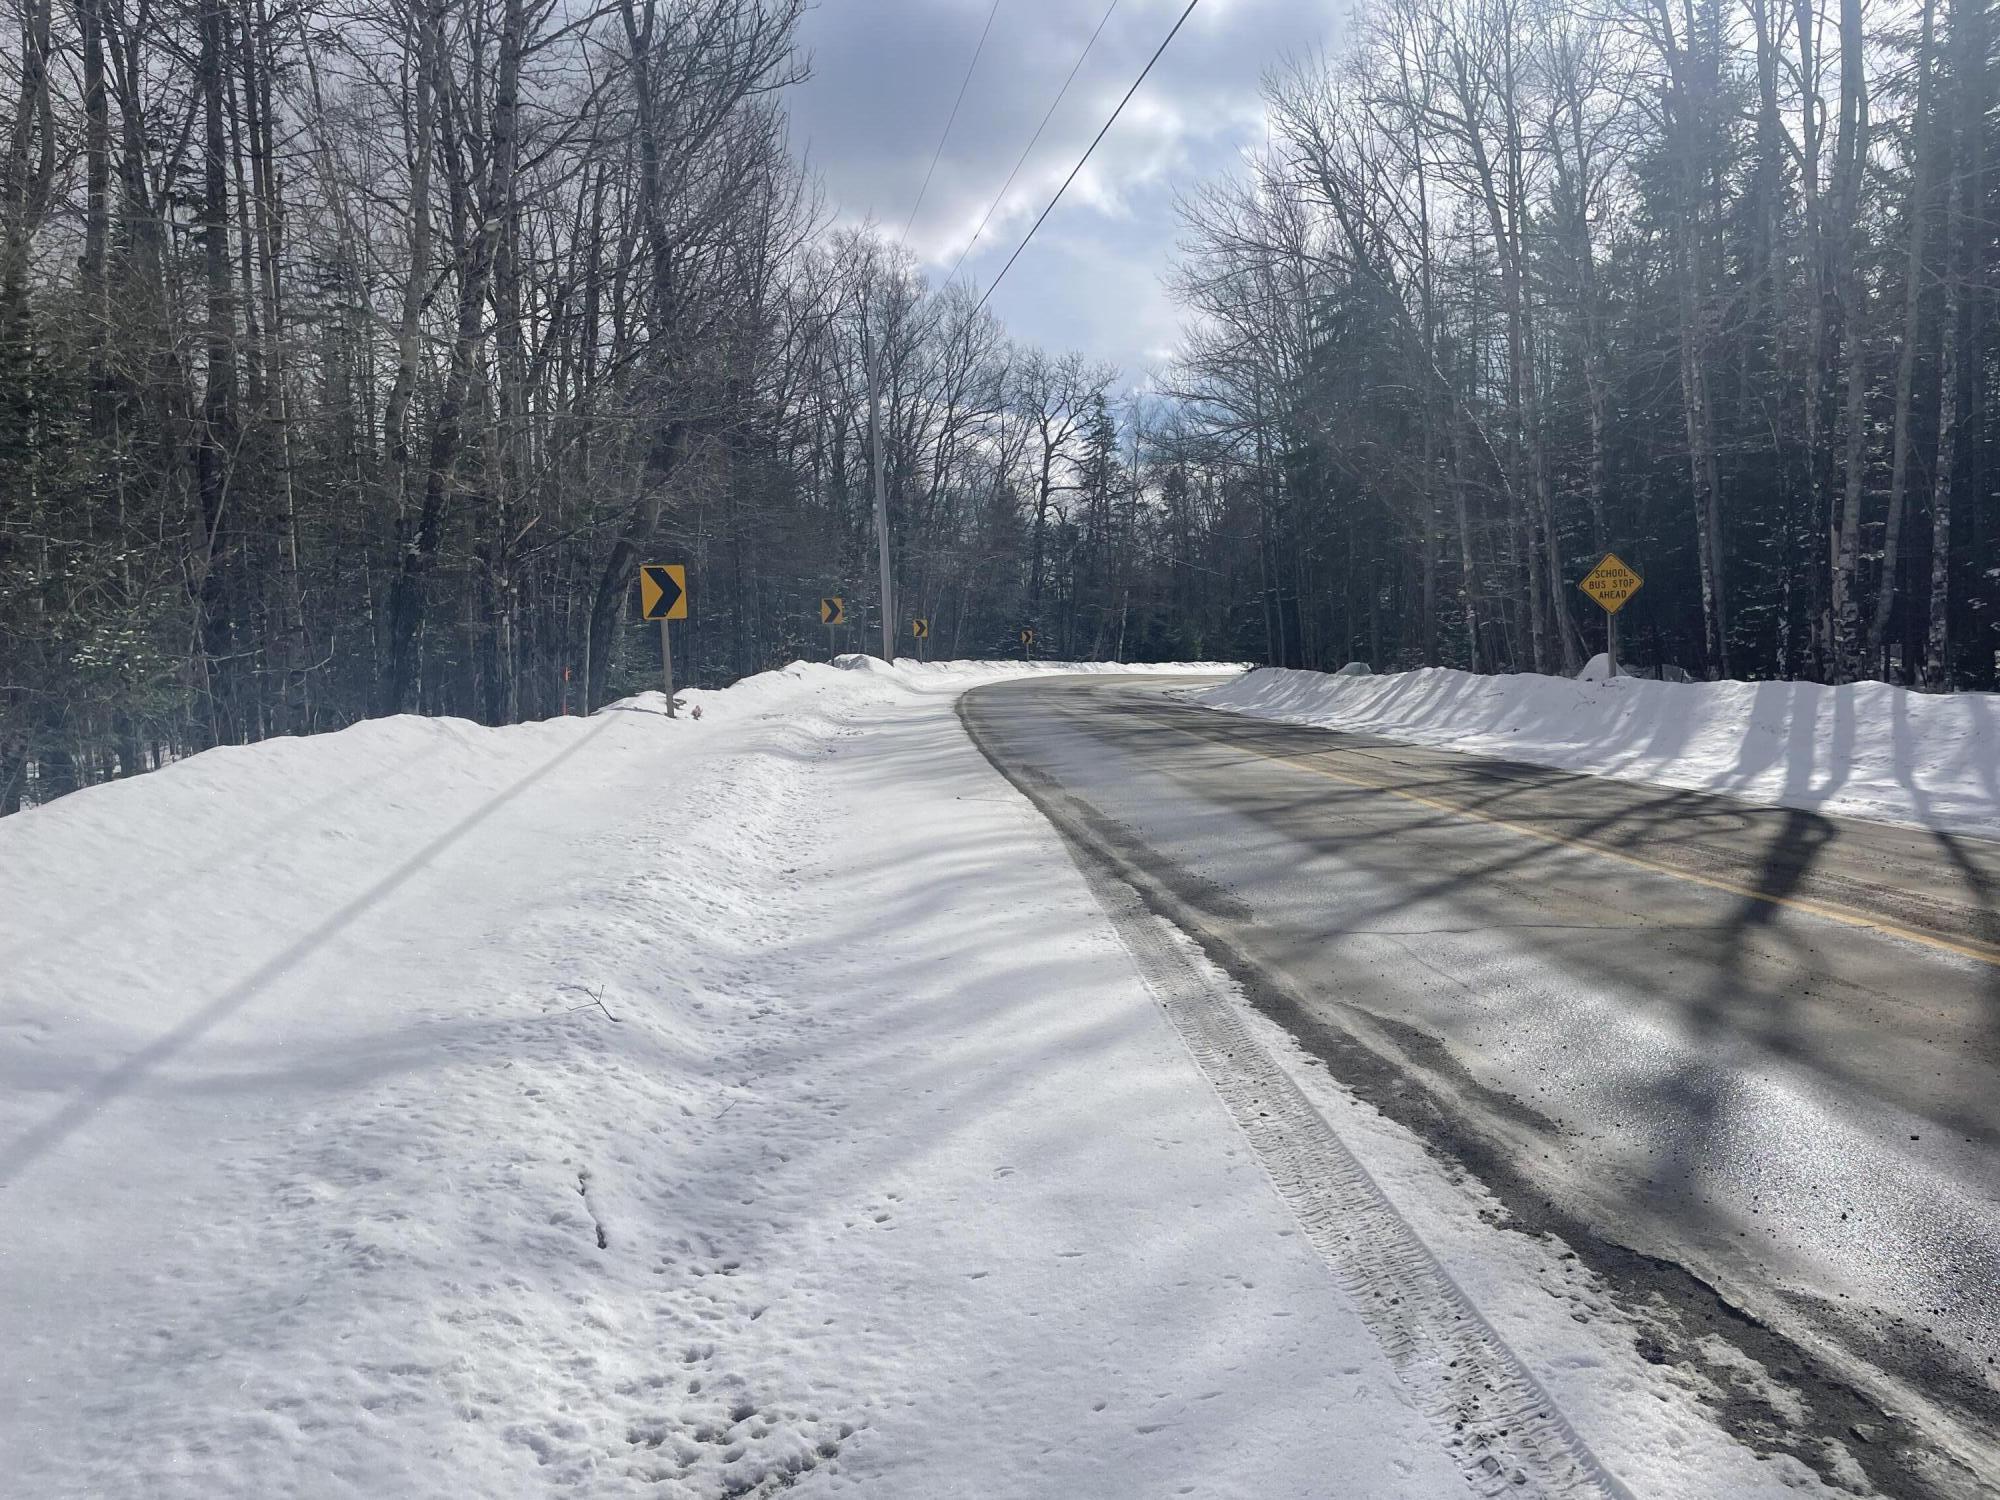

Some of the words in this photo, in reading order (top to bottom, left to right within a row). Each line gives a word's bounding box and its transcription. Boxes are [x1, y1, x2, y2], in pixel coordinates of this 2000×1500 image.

[1595, 569, 1628, 578] SCHOOL
[1589, 581, 1606, 589] BUS
[1612, 579, 1634, 588] STOP
[1599, 590, 1627, 599] AHEAD
